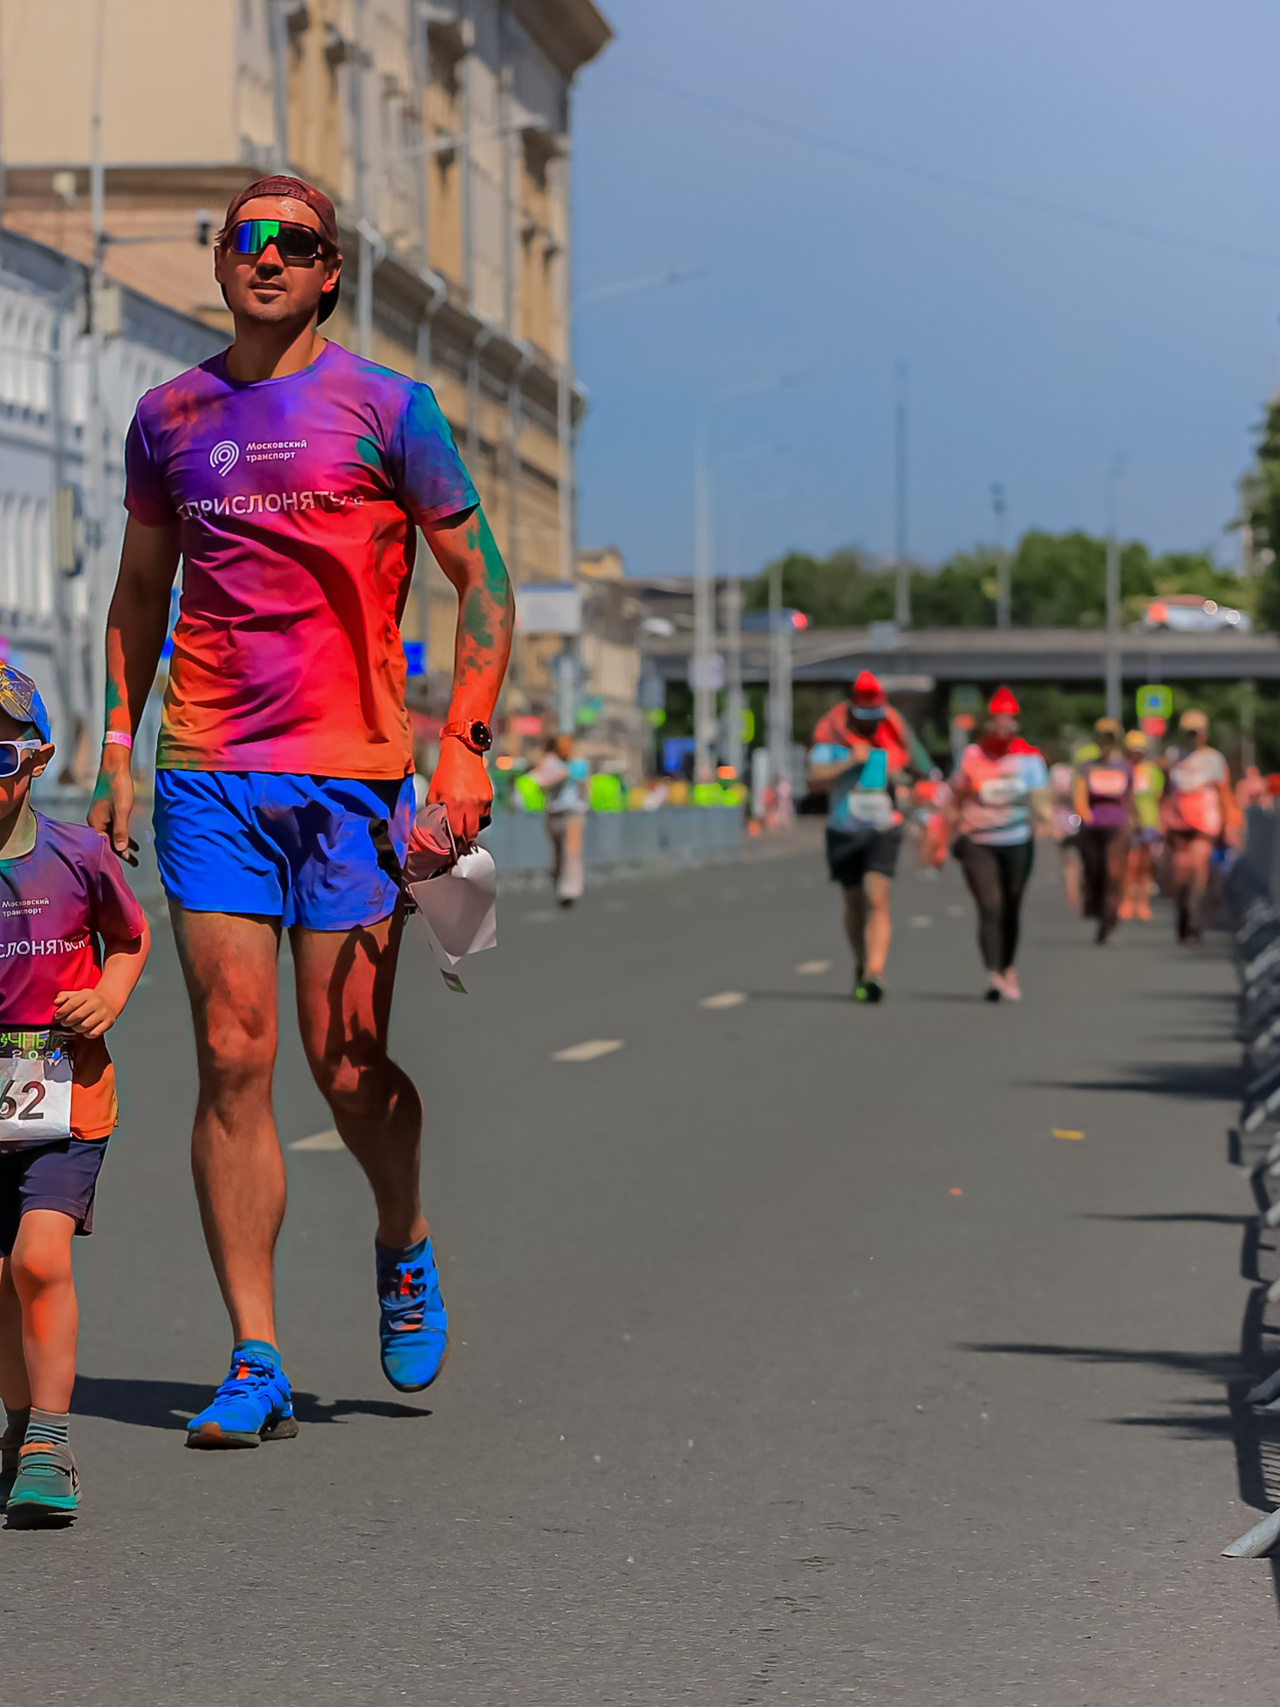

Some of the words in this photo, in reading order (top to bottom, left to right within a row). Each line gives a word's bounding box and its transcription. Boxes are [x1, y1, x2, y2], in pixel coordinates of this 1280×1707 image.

[246, 439, 308, 451] Московский
[245, 451, 296, 463] транспорт
[1, 897, 50, 909] Московский
[1, 907, 42, 918] транспорт
